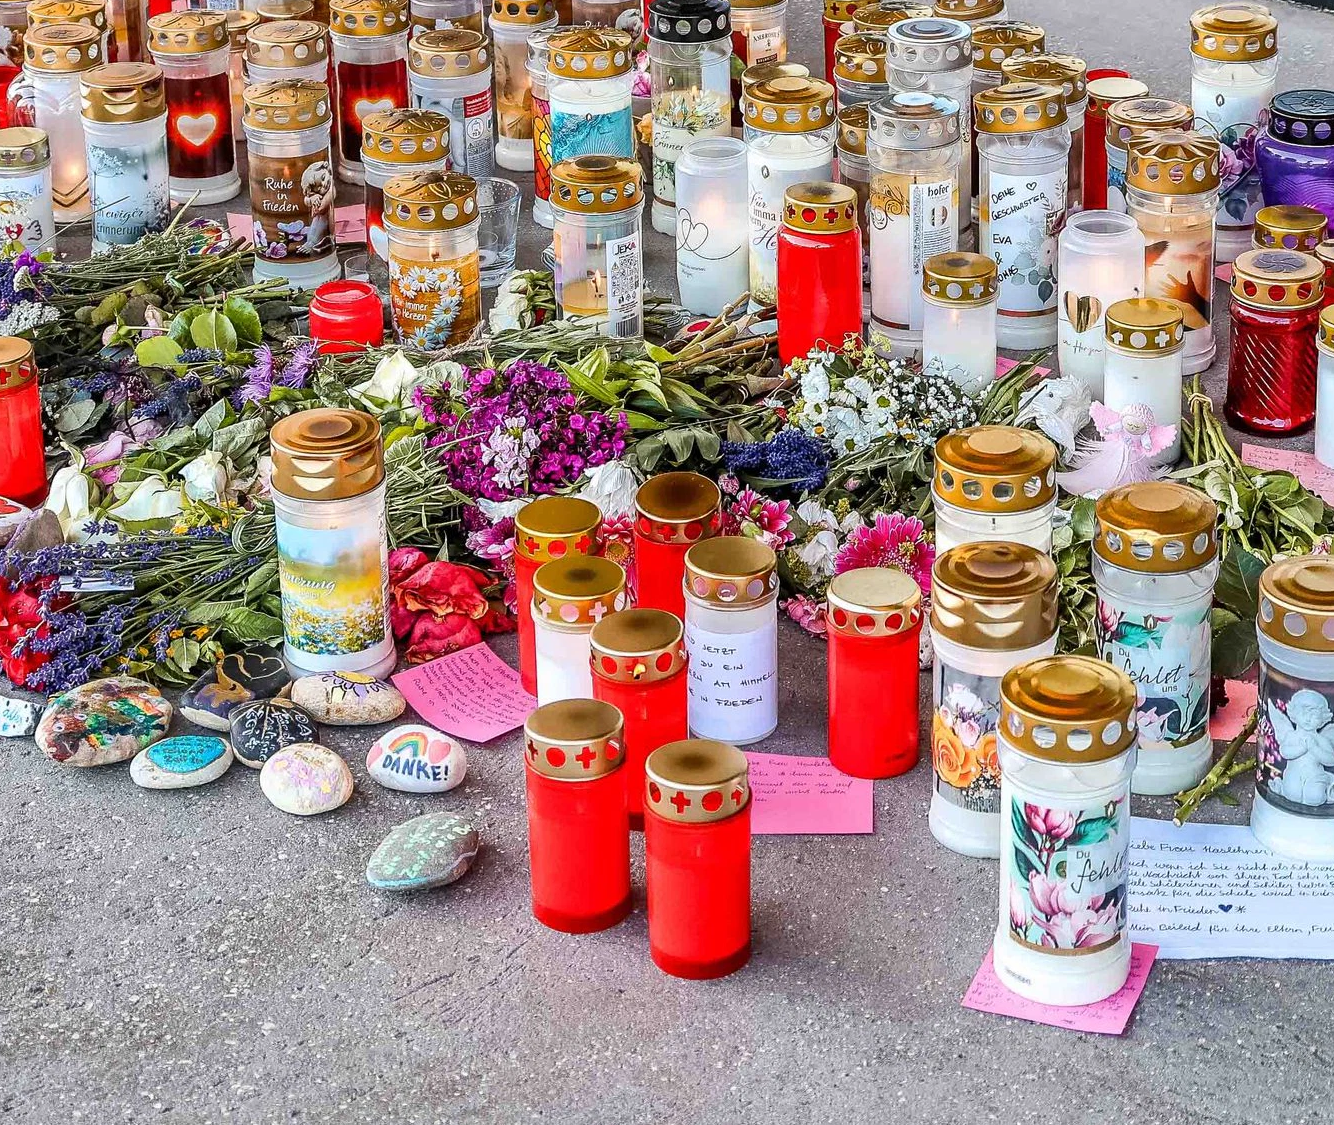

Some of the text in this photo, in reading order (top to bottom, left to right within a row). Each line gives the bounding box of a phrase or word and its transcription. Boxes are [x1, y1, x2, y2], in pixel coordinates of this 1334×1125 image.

[654, 132, 685, 151] Erinner
[264, 178, 294, 190] Ruhe
[277, 191, 288, 200] in
[927, 185, 950, 198] hofer
[262, 200, 300, 213] Frieden
[96, 221, 146, 236] Erinnerun
[615, 241, 637, 256] JEKA
[702, 644, 737, 656] JETZT
[1118, 647, 1130, 658] Du
[700, 659, 744, 671] DU EIN
[713, 679, 731, 689] AM
[1161, 684, 1178, 694] uns
[700, 695, 764, 708] IN FRIEDEN
[382, 754, 450, 782] DANKE!
[1128, 840, 1156, 851] iebe
[1159, 842, 1196, 853] Frau
[1075, 850, 1091, 860] Du
[1128, 860, 1150, 870] uch
[1154, 862, 1182, 871] wenn
[1187, 860, 1209, 871] ich
[1212, 861, 1230, 871] Sie
[1236, 861, 1268, 872] nicht
[1274, 870, 1293, 881] Tod
[1127, 877, 1147, 887] iele
[1227, 878, 1250, 889] und
[1127, 889, 1169, 897] insatz
[1171, 889, 1193, 899] für
[1195, 888, 1218, 898] die
[1174, 905, 1218, 916] Frieden
[1129, 923, 1155, 933] Mein
